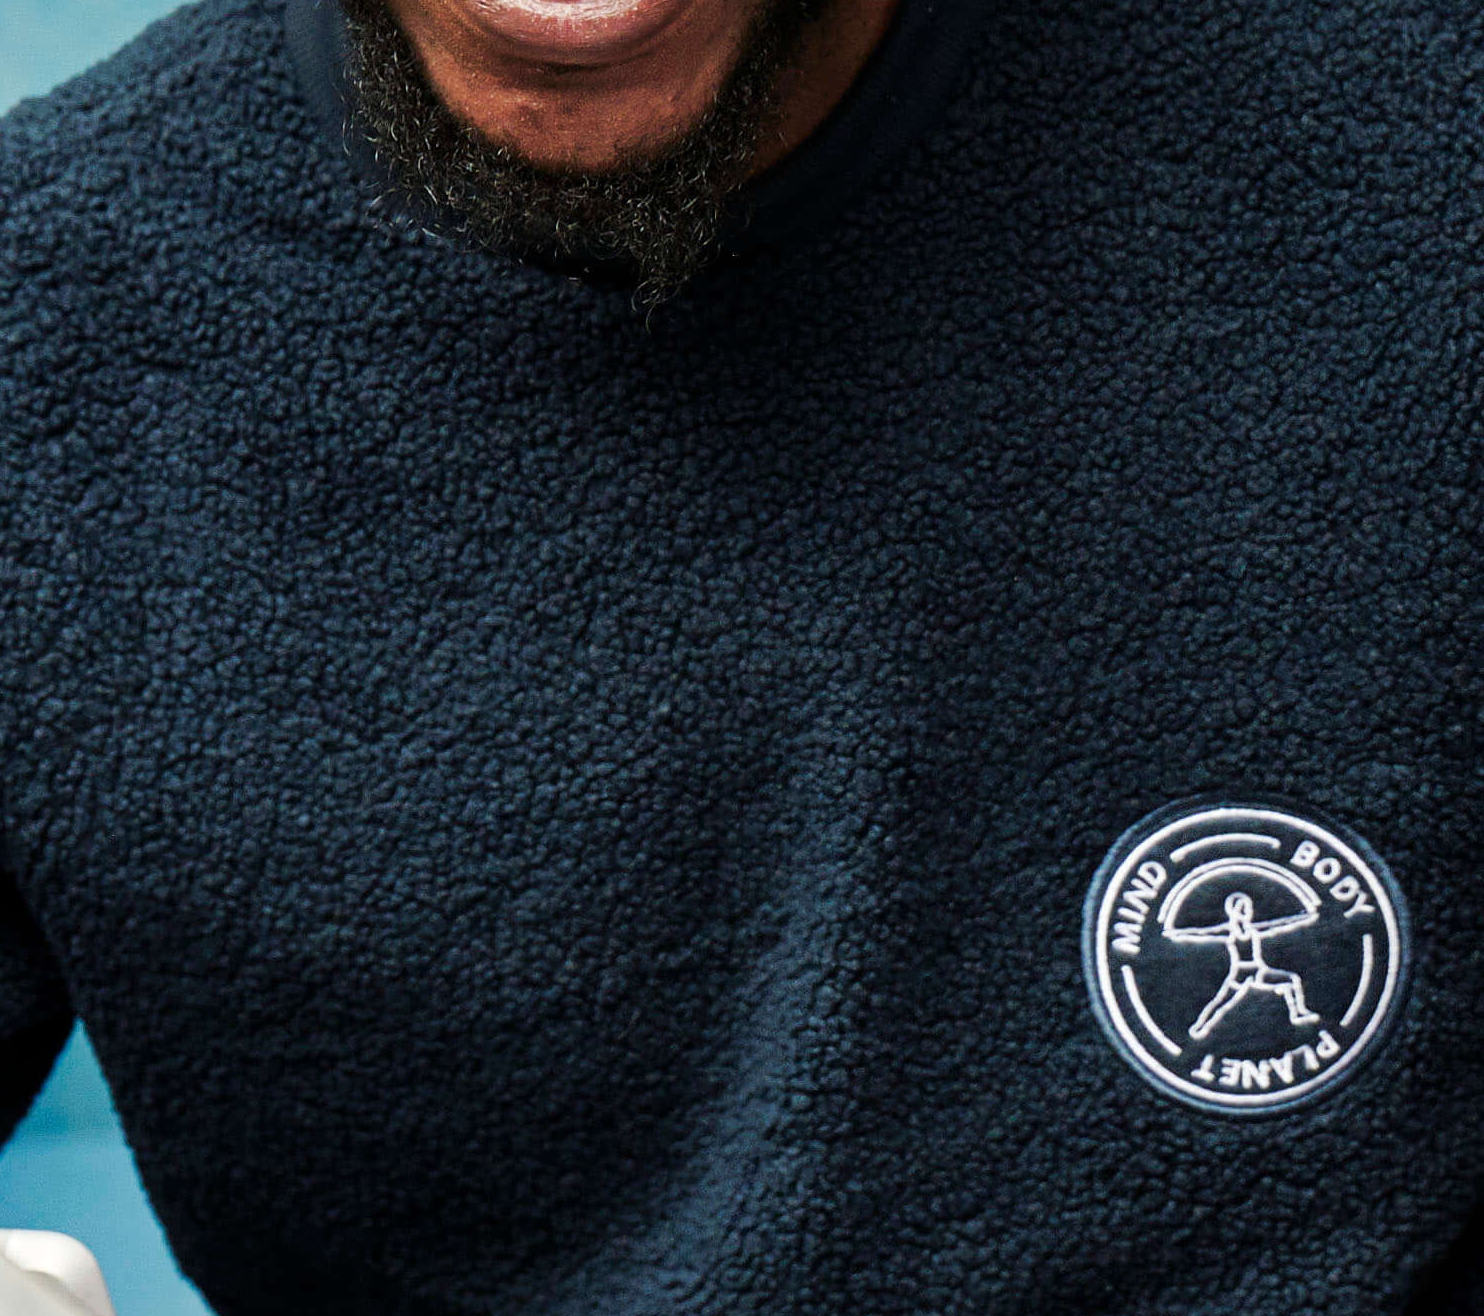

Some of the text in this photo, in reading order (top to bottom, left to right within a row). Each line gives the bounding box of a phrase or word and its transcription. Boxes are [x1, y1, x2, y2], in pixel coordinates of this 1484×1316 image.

[1112, 860, 1168, 955] MIND
[1289, 839, 1376, 919] BODY
[1190, 1029, 1341, 1089] PLANET
